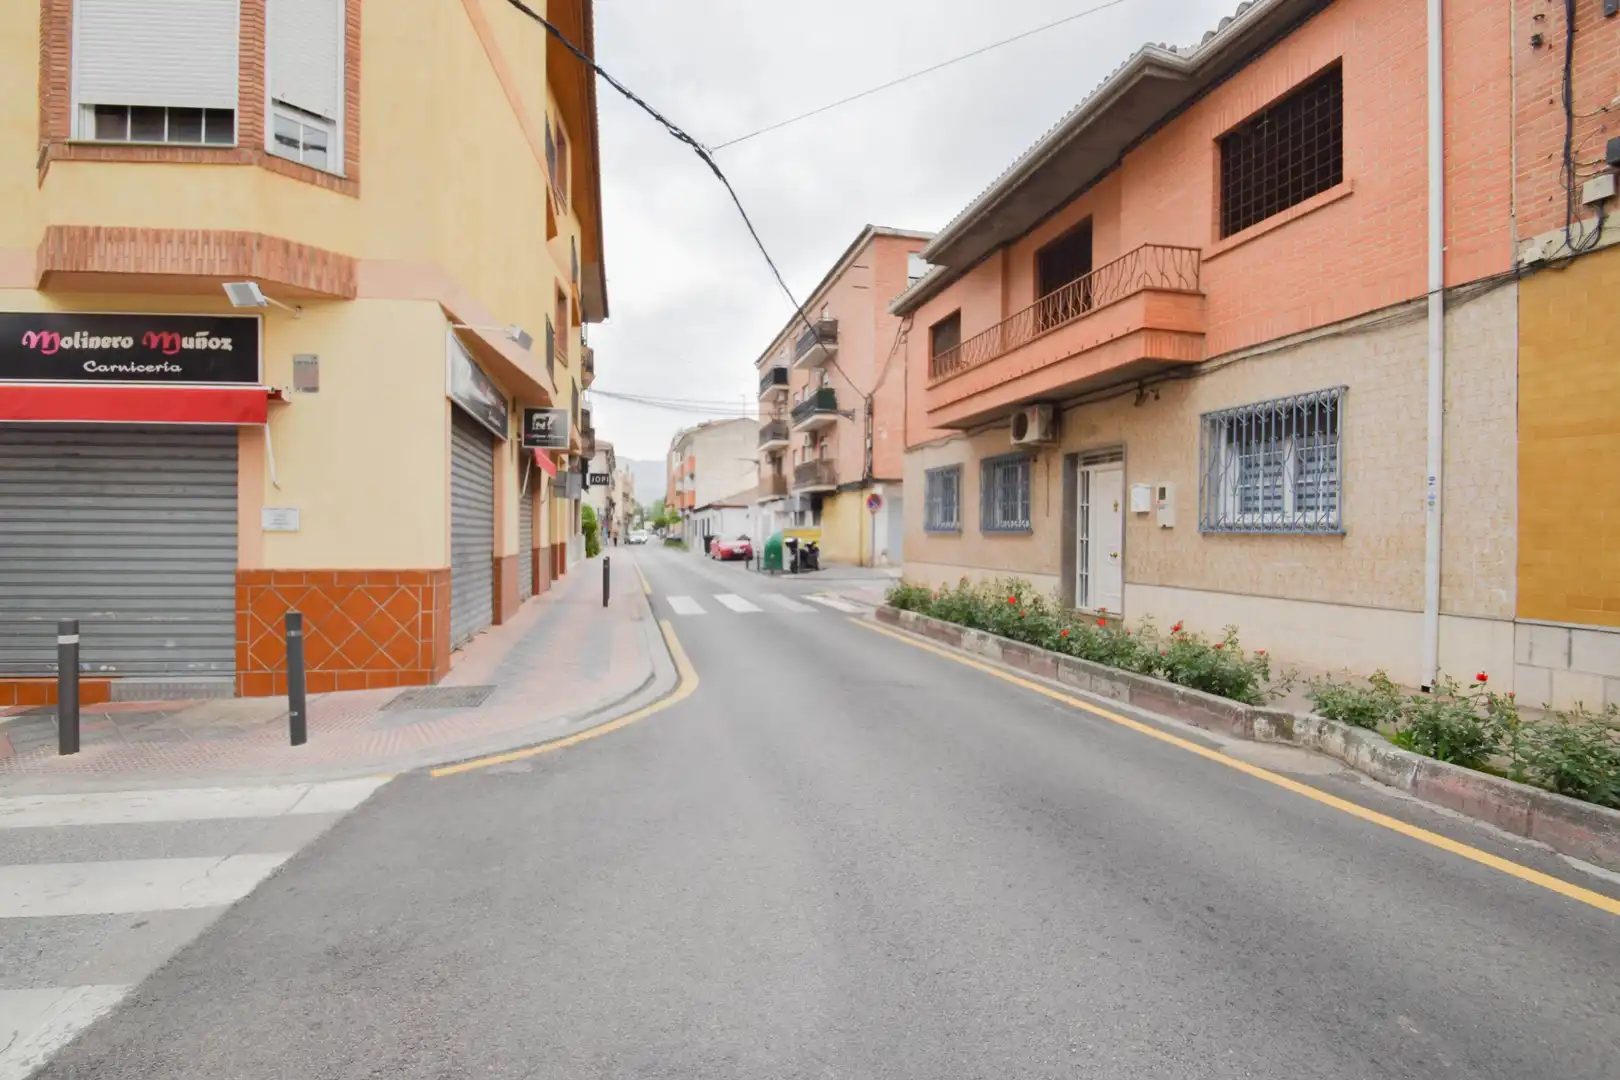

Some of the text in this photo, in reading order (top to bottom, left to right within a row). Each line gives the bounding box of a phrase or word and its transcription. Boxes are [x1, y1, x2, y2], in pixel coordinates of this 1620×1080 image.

[21, 330, 233, 355] Molinero Muñoz
[83, 360, 182, 373] Carnicería
